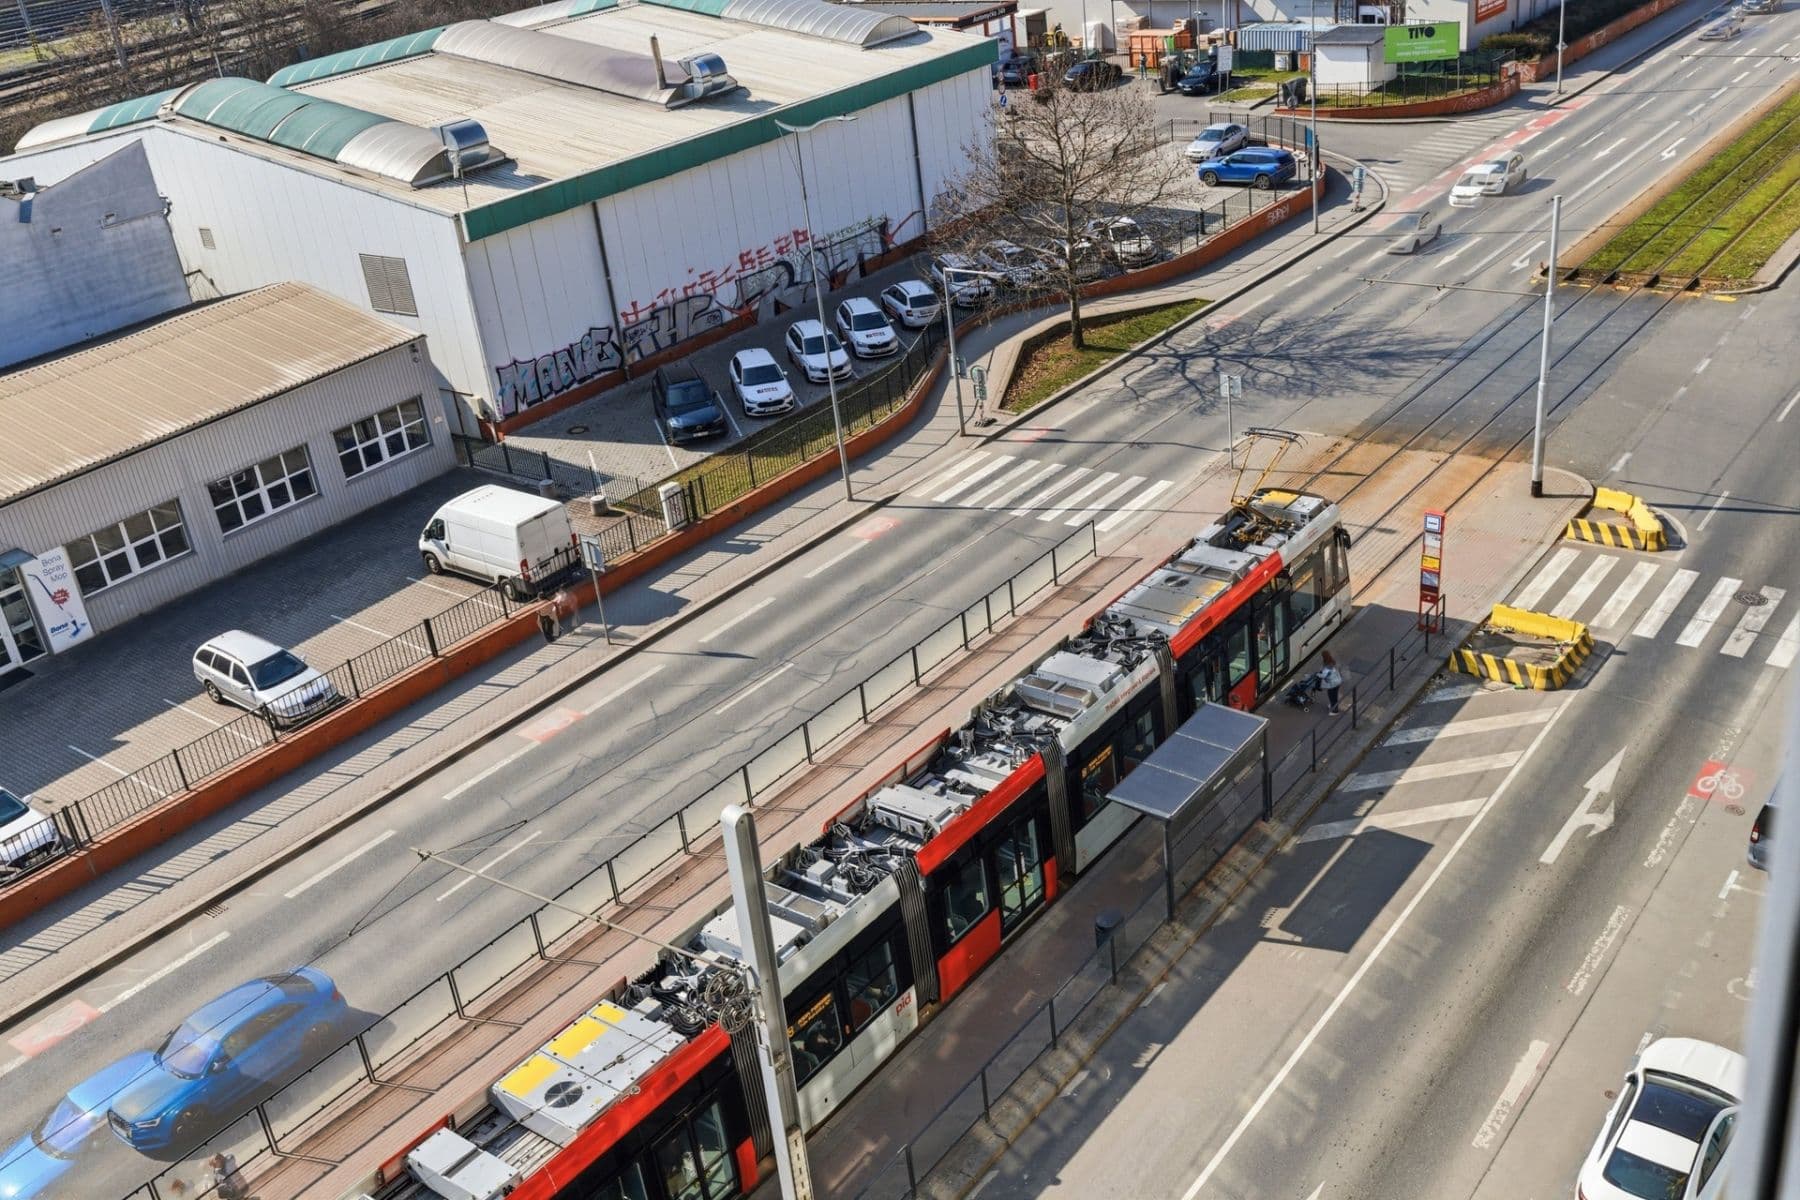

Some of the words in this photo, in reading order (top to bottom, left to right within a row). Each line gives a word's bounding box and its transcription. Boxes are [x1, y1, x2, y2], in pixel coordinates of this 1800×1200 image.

[41, 555, 61, 567] Bona
[42, 564, 64, 577] Spray
[896, 992, 912, 1016] pid
